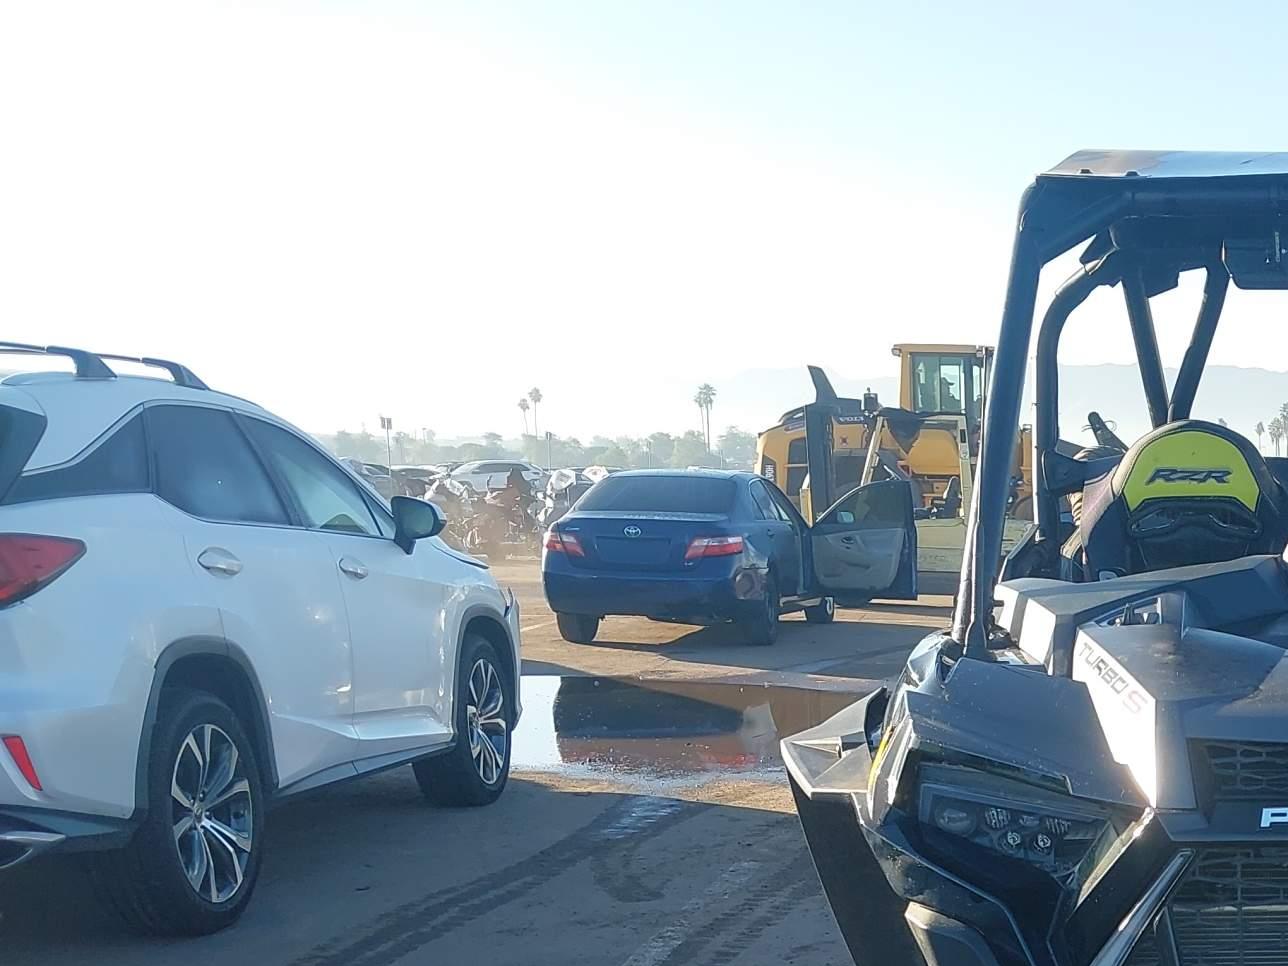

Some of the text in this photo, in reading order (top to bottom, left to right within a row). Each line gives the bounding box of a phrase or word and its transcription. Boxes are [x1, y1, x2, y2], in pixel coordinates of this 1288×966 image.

[1145, 467, 1232, 485] RZR
[1079, 642, 1148, 714] TURBO S
